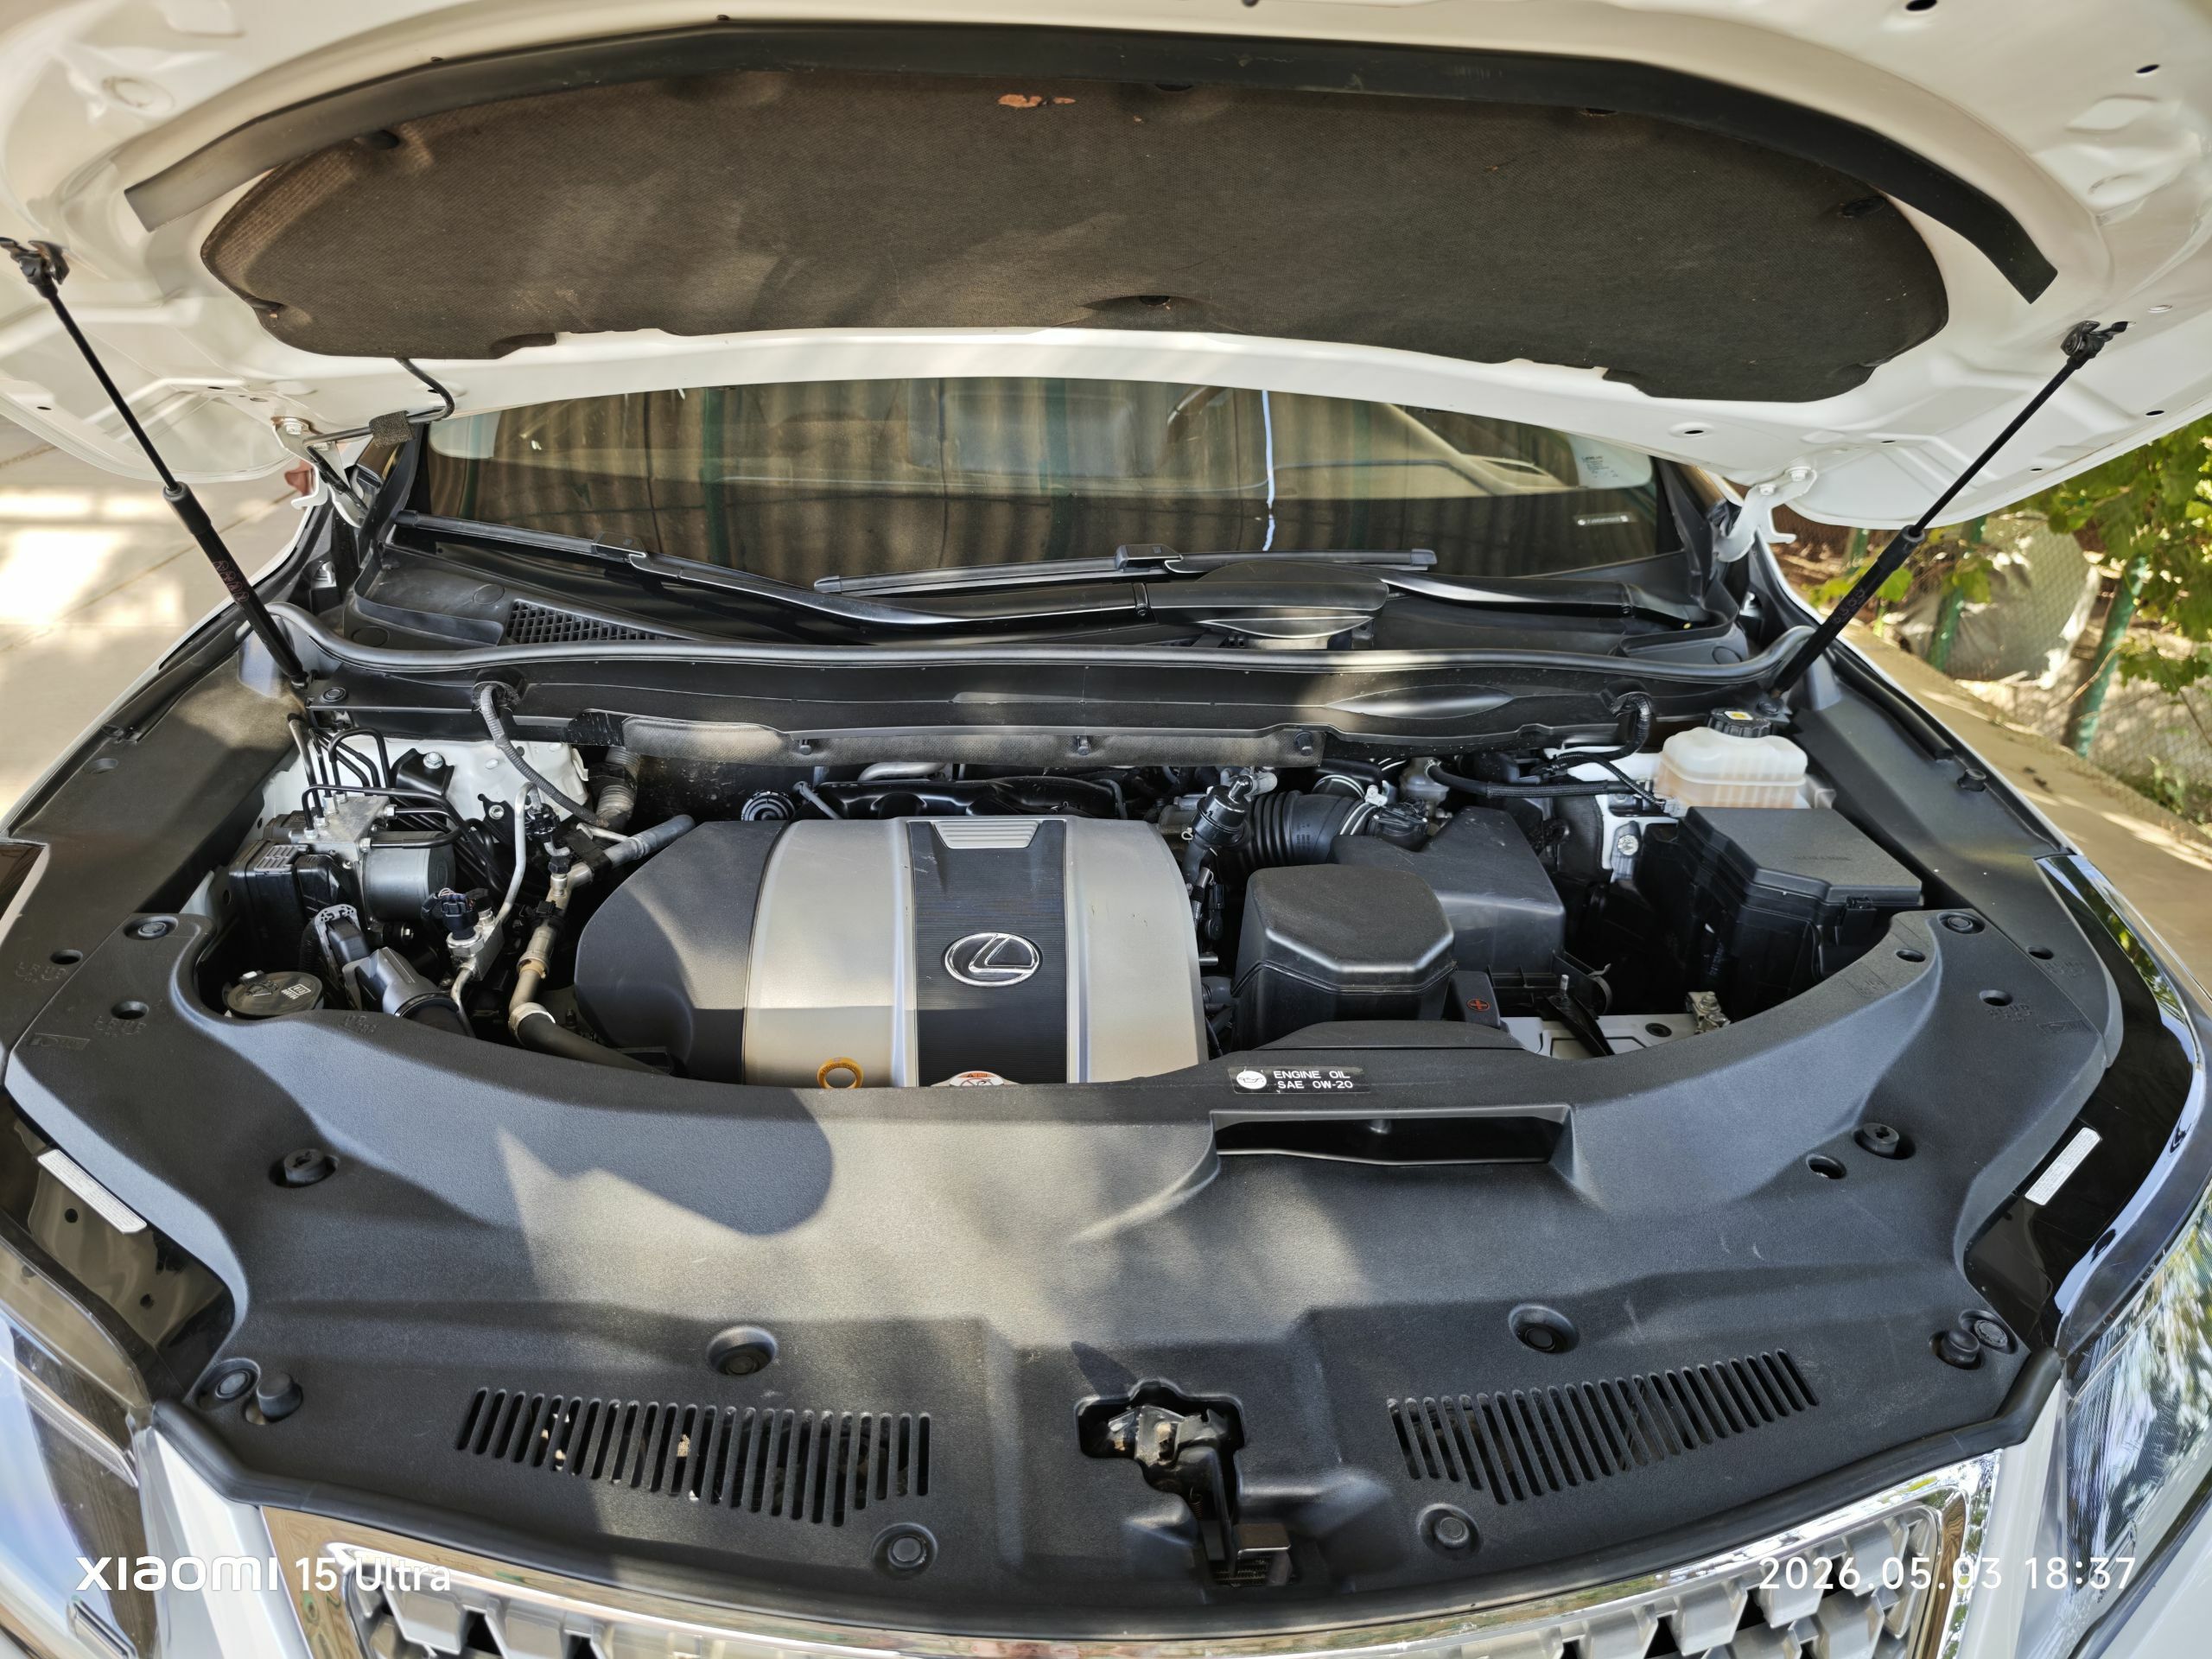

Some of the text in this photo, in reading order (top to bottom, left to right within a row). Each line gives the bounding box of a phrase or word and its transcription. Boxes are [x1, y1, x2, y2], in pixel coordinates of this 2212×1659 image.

[1273, 1071, 1351, 1079] ENGINE OIL
[1277, 1080, 1353, 1090] SAE 0W-20
